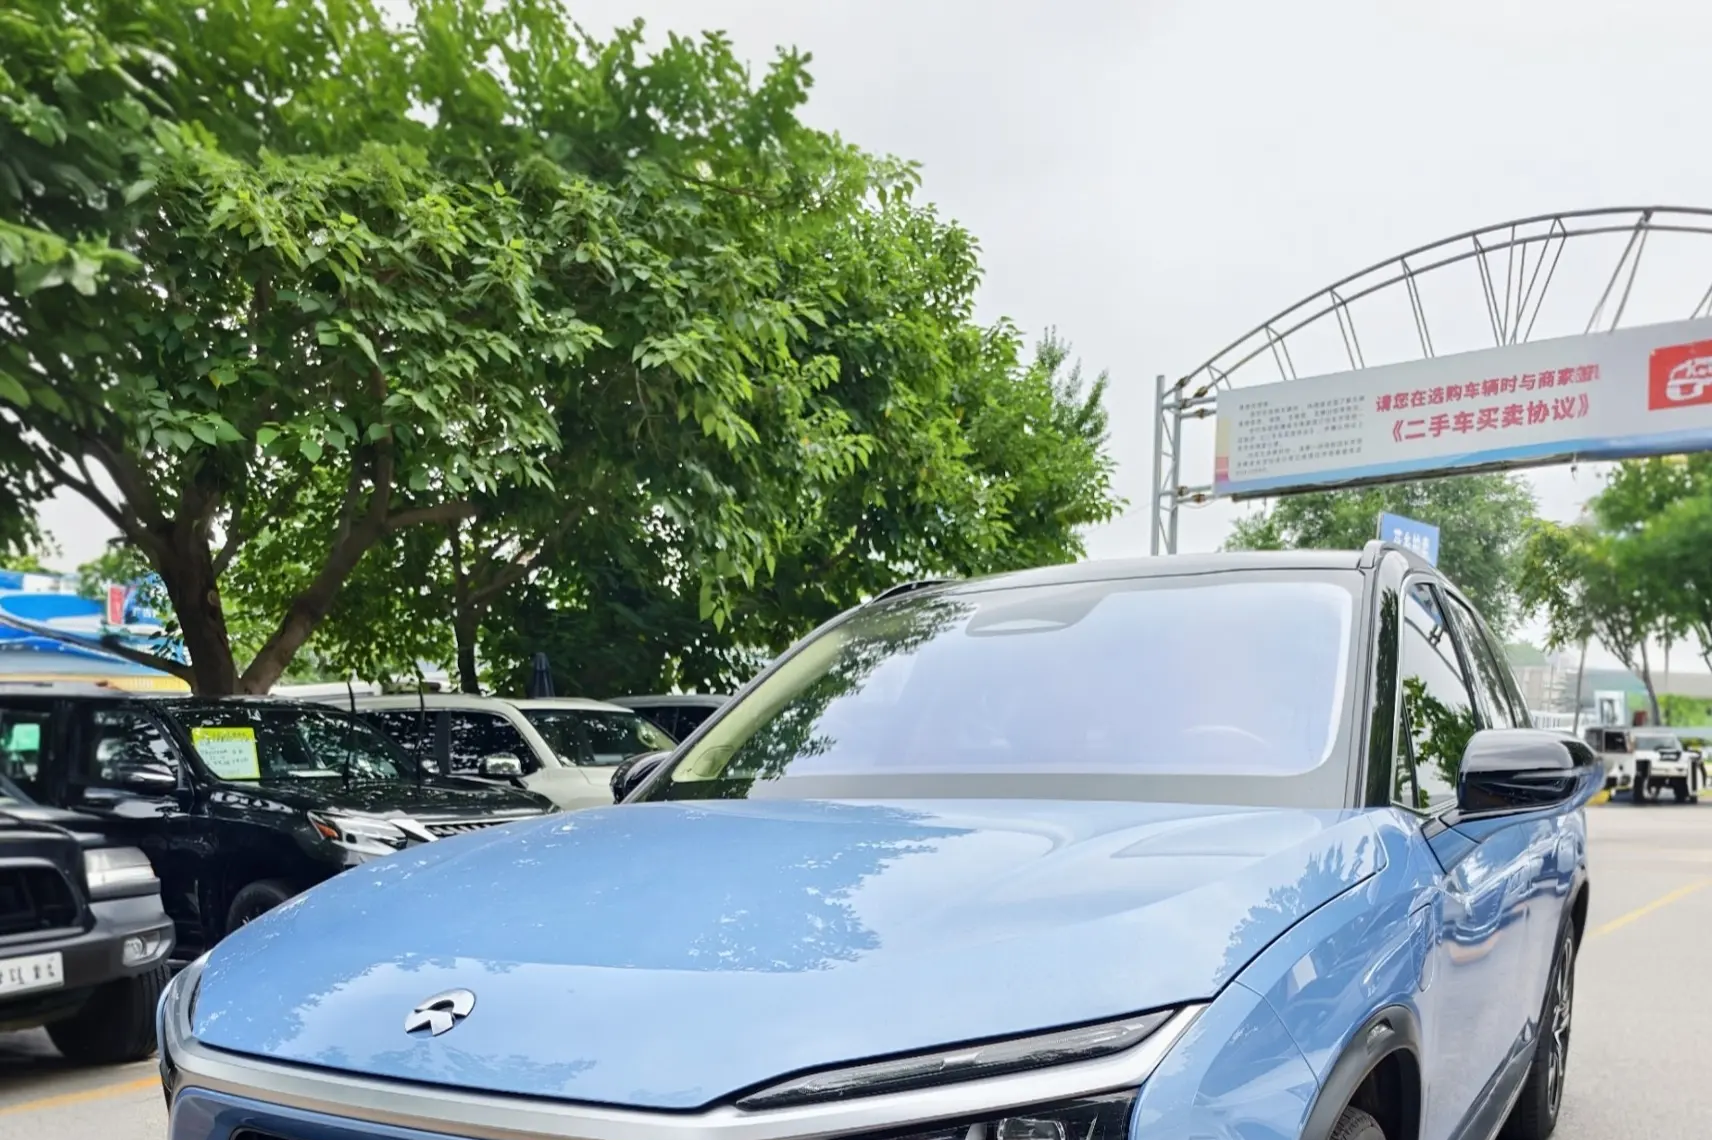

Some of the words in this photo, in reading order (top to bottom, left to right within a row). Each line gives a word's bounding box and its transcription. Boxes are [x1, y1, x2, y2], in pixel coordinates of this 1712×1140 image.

[1392, 393, 1590, 442] 《二手车买卖协议》
